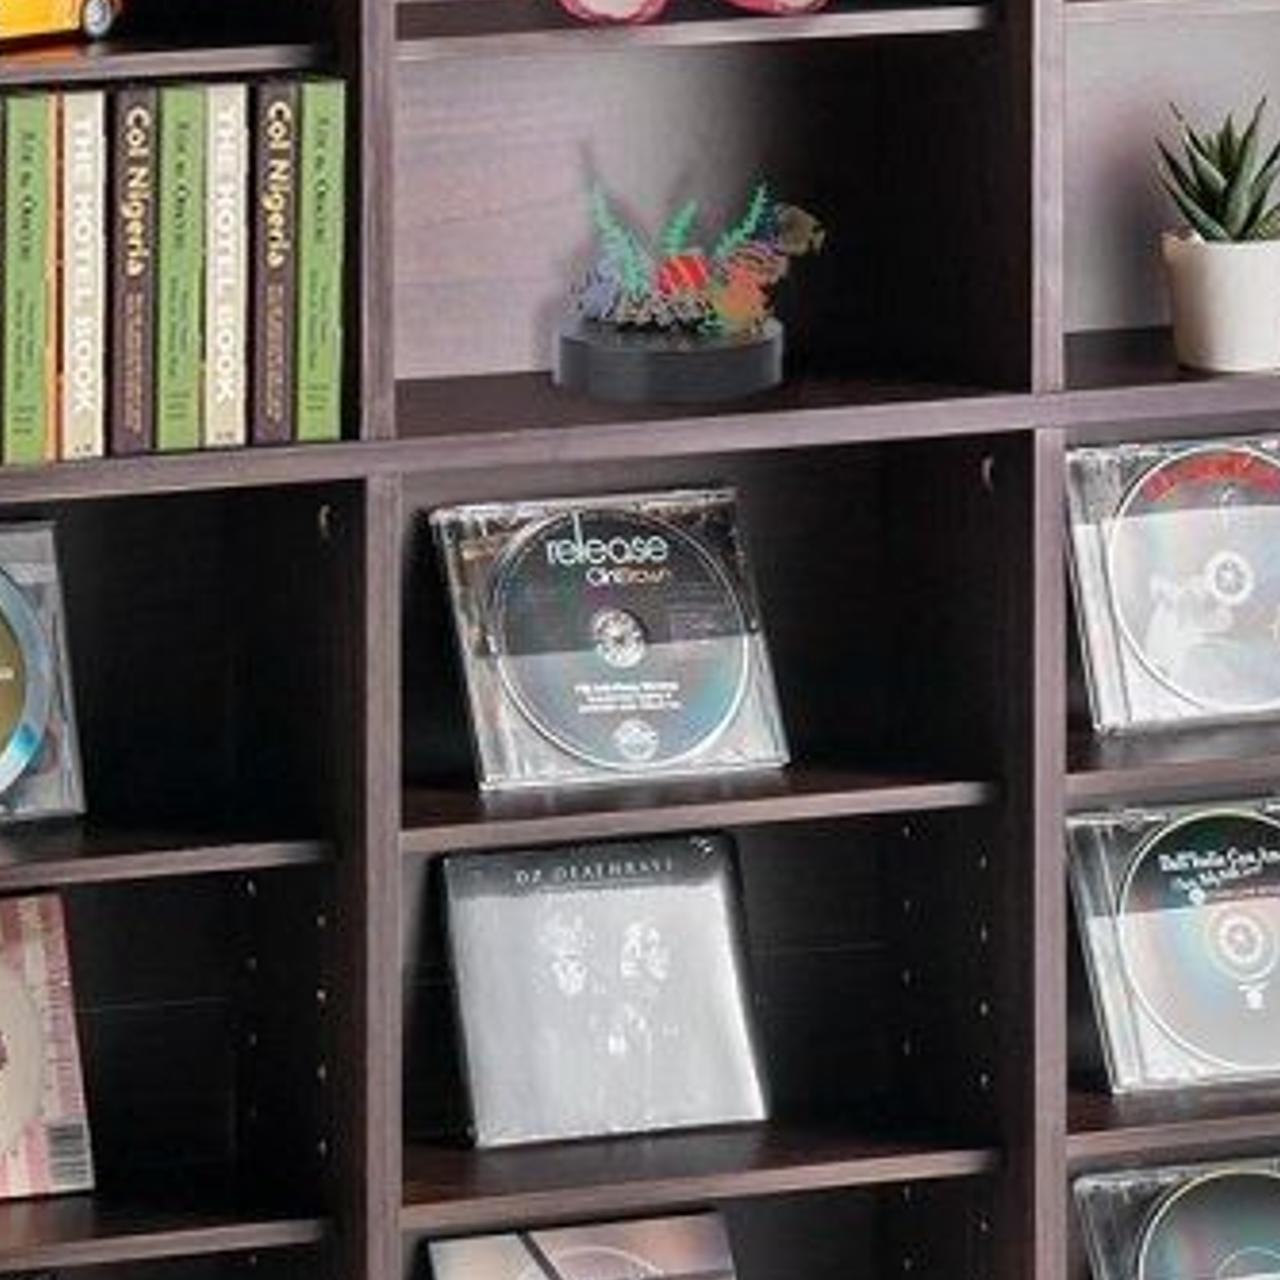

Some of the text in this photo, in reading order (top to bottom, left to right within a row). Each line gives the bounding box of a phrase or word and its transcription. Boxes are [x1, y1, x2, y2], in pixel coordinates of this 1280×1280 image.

[125, 106, 150, 158] Col
[266, 100, 292, 151] Col
[71, 113, 95, 415] THE HOTEL BOOK
[120, 165, 150, 277] Nigeria
[214, 105, 238, 404] THE HOTEL BOOK
[261, 158, 292, 269] Nigeria
[546, 512, 670, 566] release
